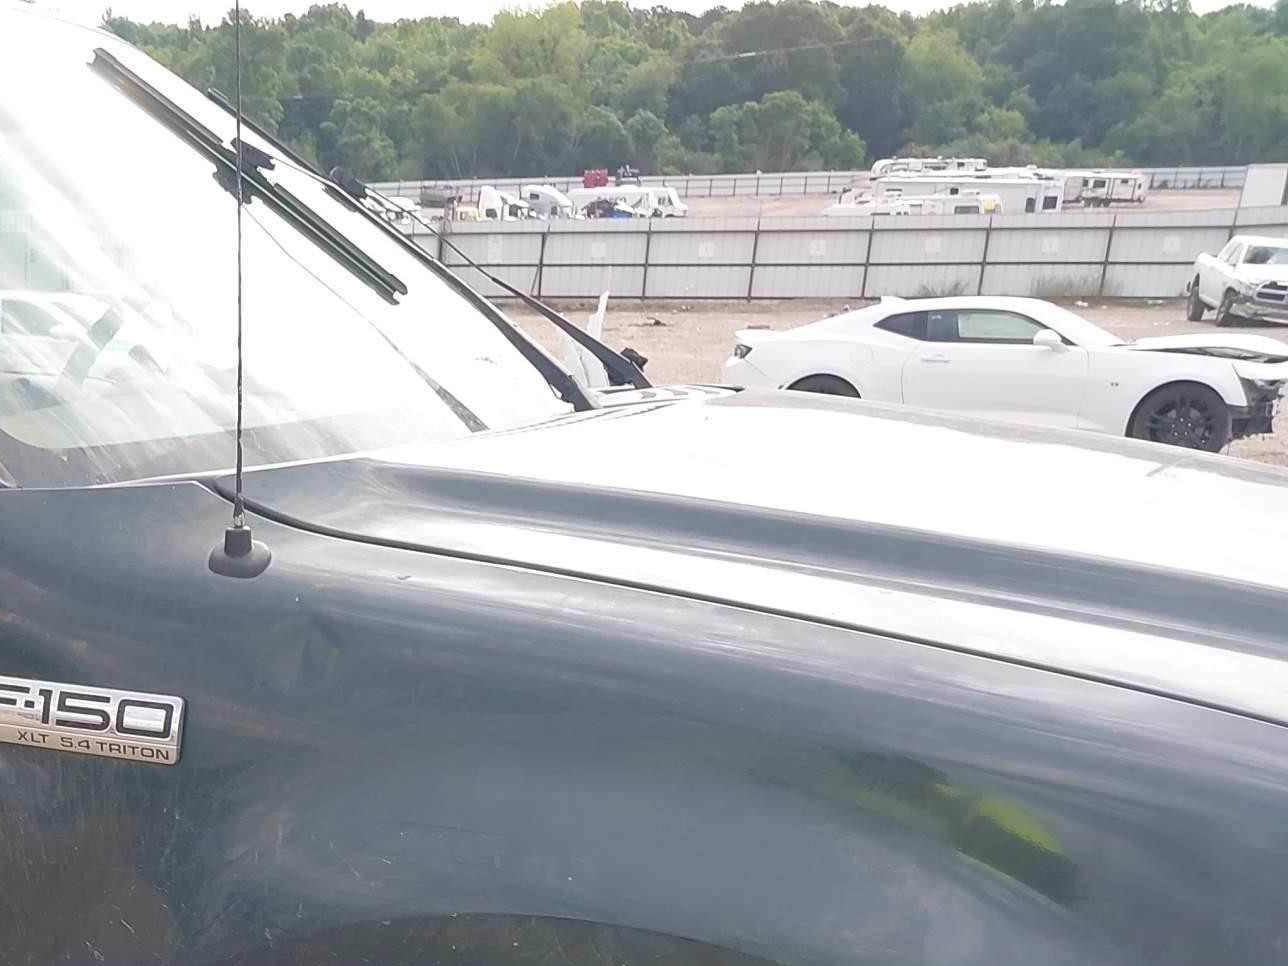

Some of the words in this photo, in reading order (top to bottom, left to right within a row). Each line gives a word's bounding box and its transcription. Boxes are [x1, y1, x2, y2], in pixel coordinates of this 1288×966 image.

[16, 729, 49, 744] XLT
[60, 736, 91, 751] 5.4
[95, 740, 170, 761] TRITON
